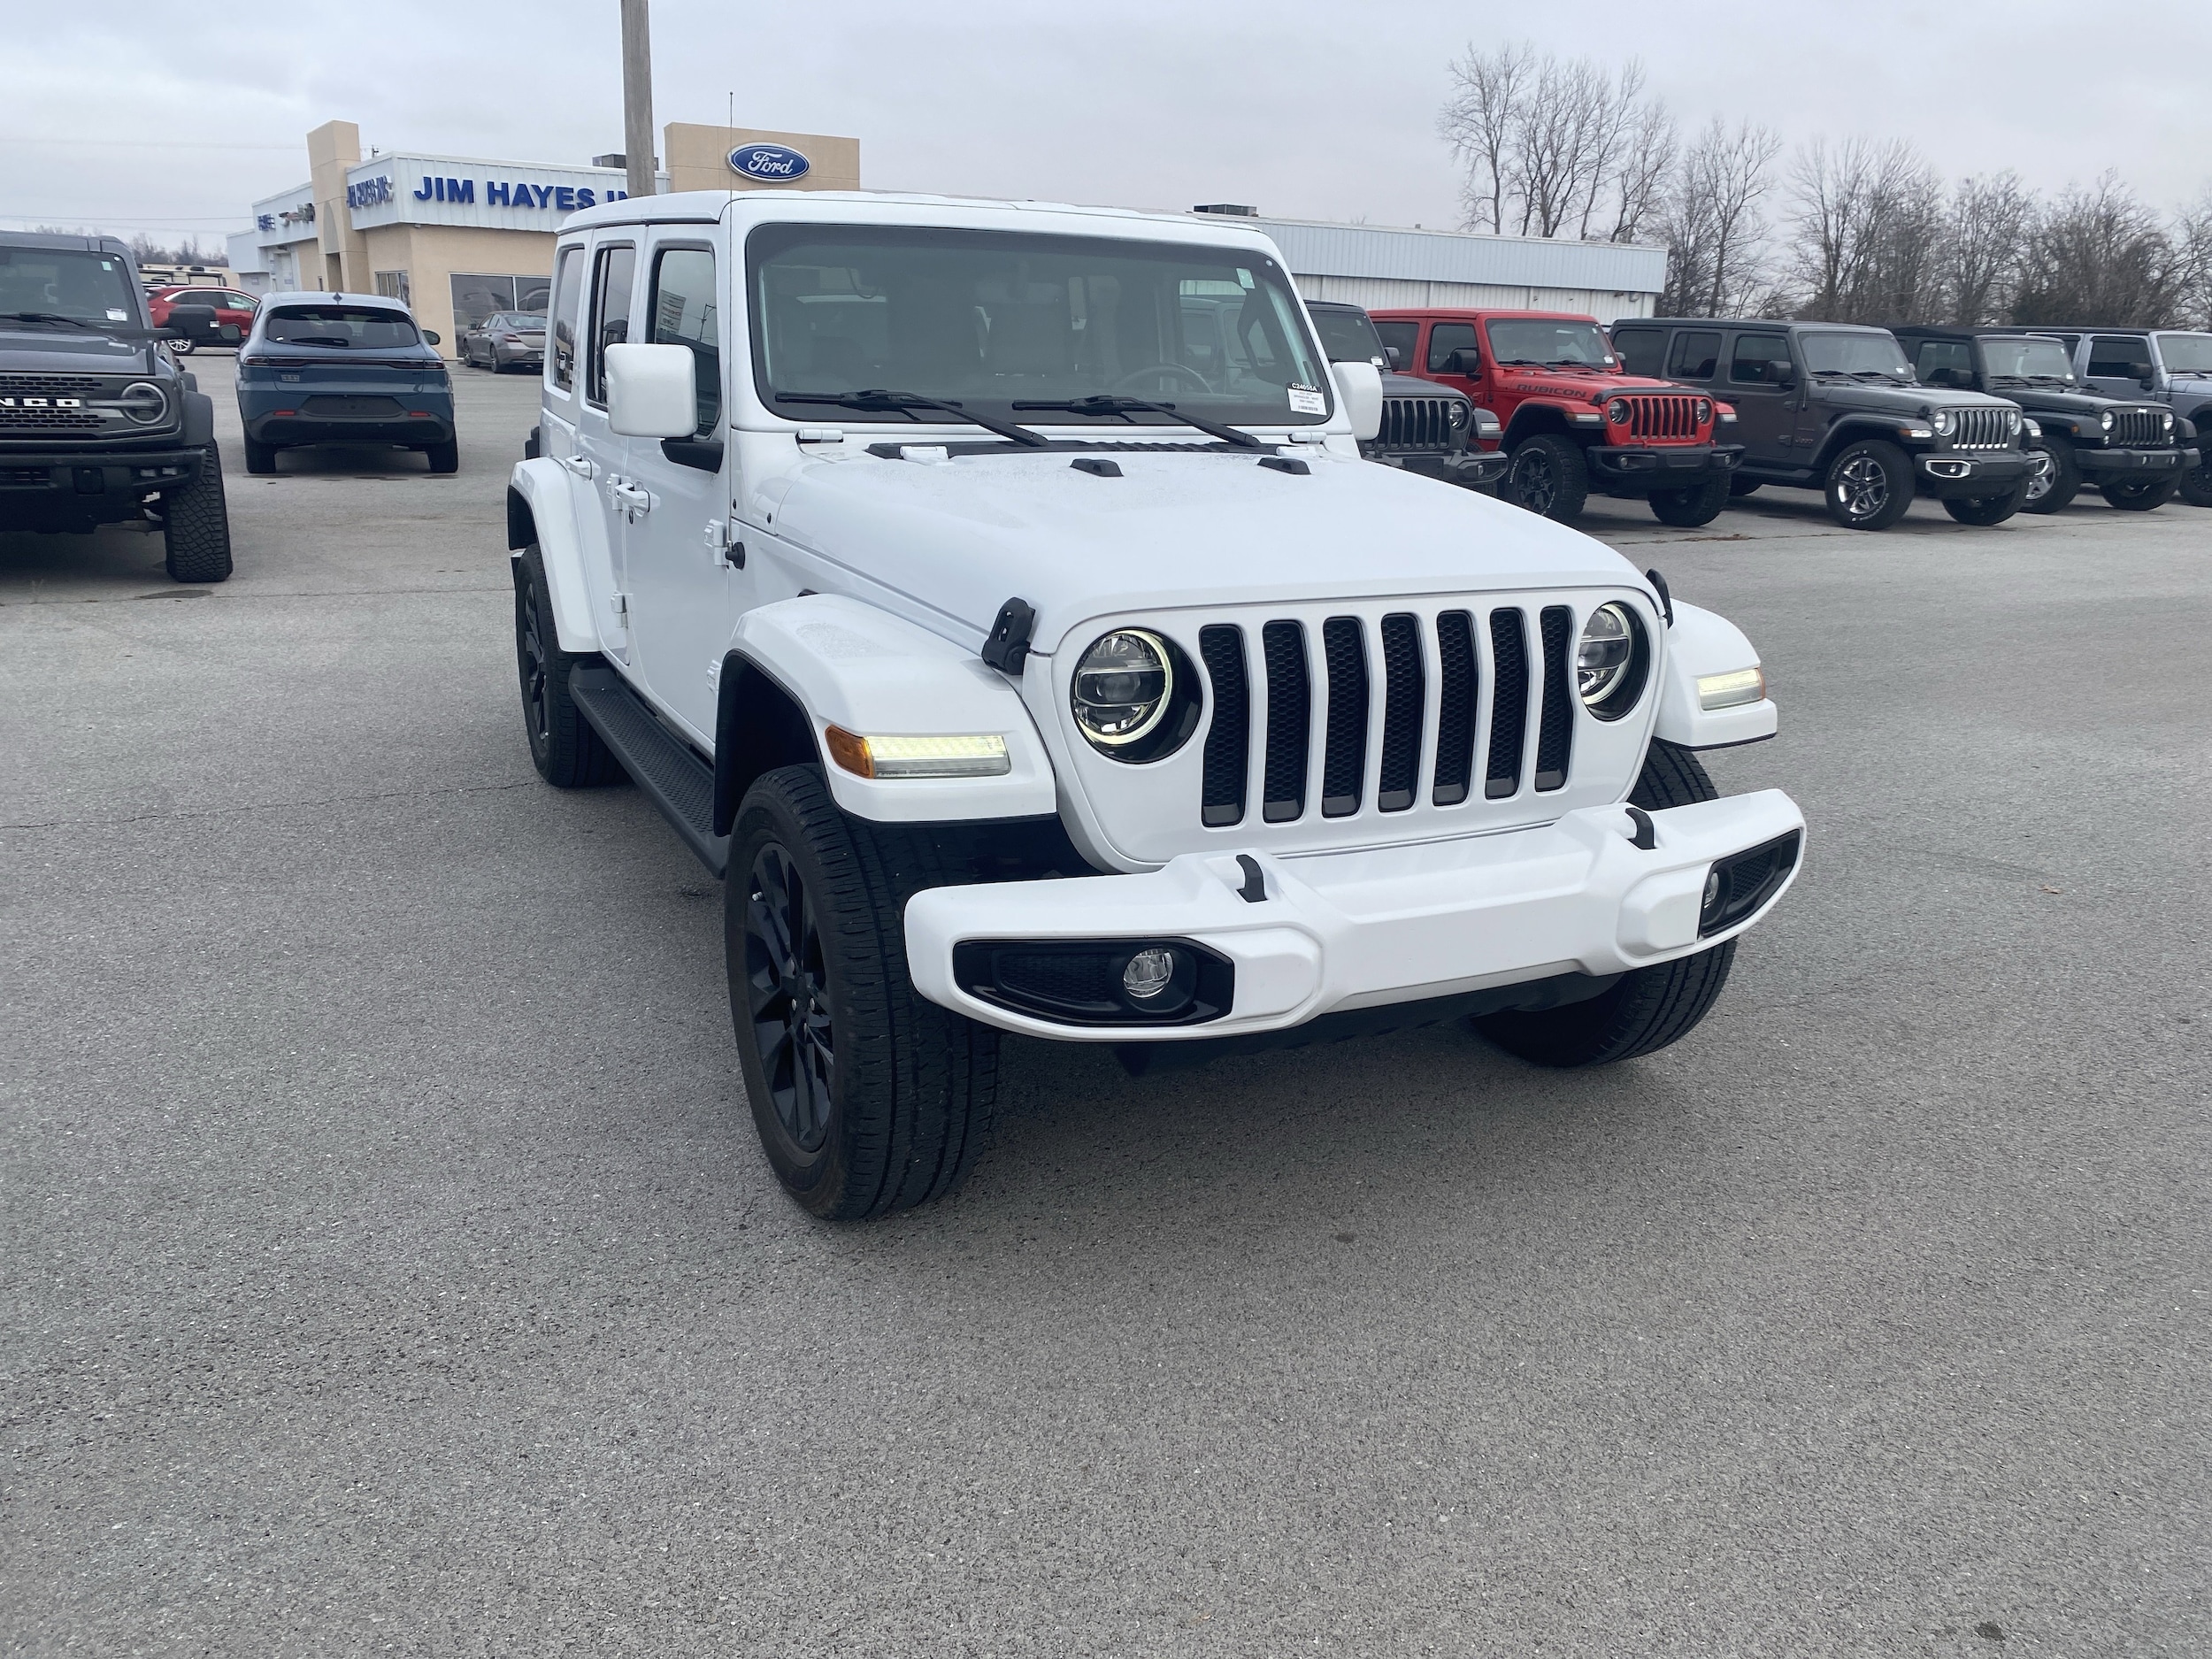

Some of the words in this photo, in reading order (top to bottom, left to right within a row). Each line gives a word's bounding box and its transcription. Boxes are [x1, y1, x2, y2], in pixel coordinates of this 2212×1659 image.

[748, 151, 793, 174] Ford
[413, 176, 474, 204] JIM
[487, 180, 596, 211] HAYES
[1516, 384, 1587, 397] RUBICON
